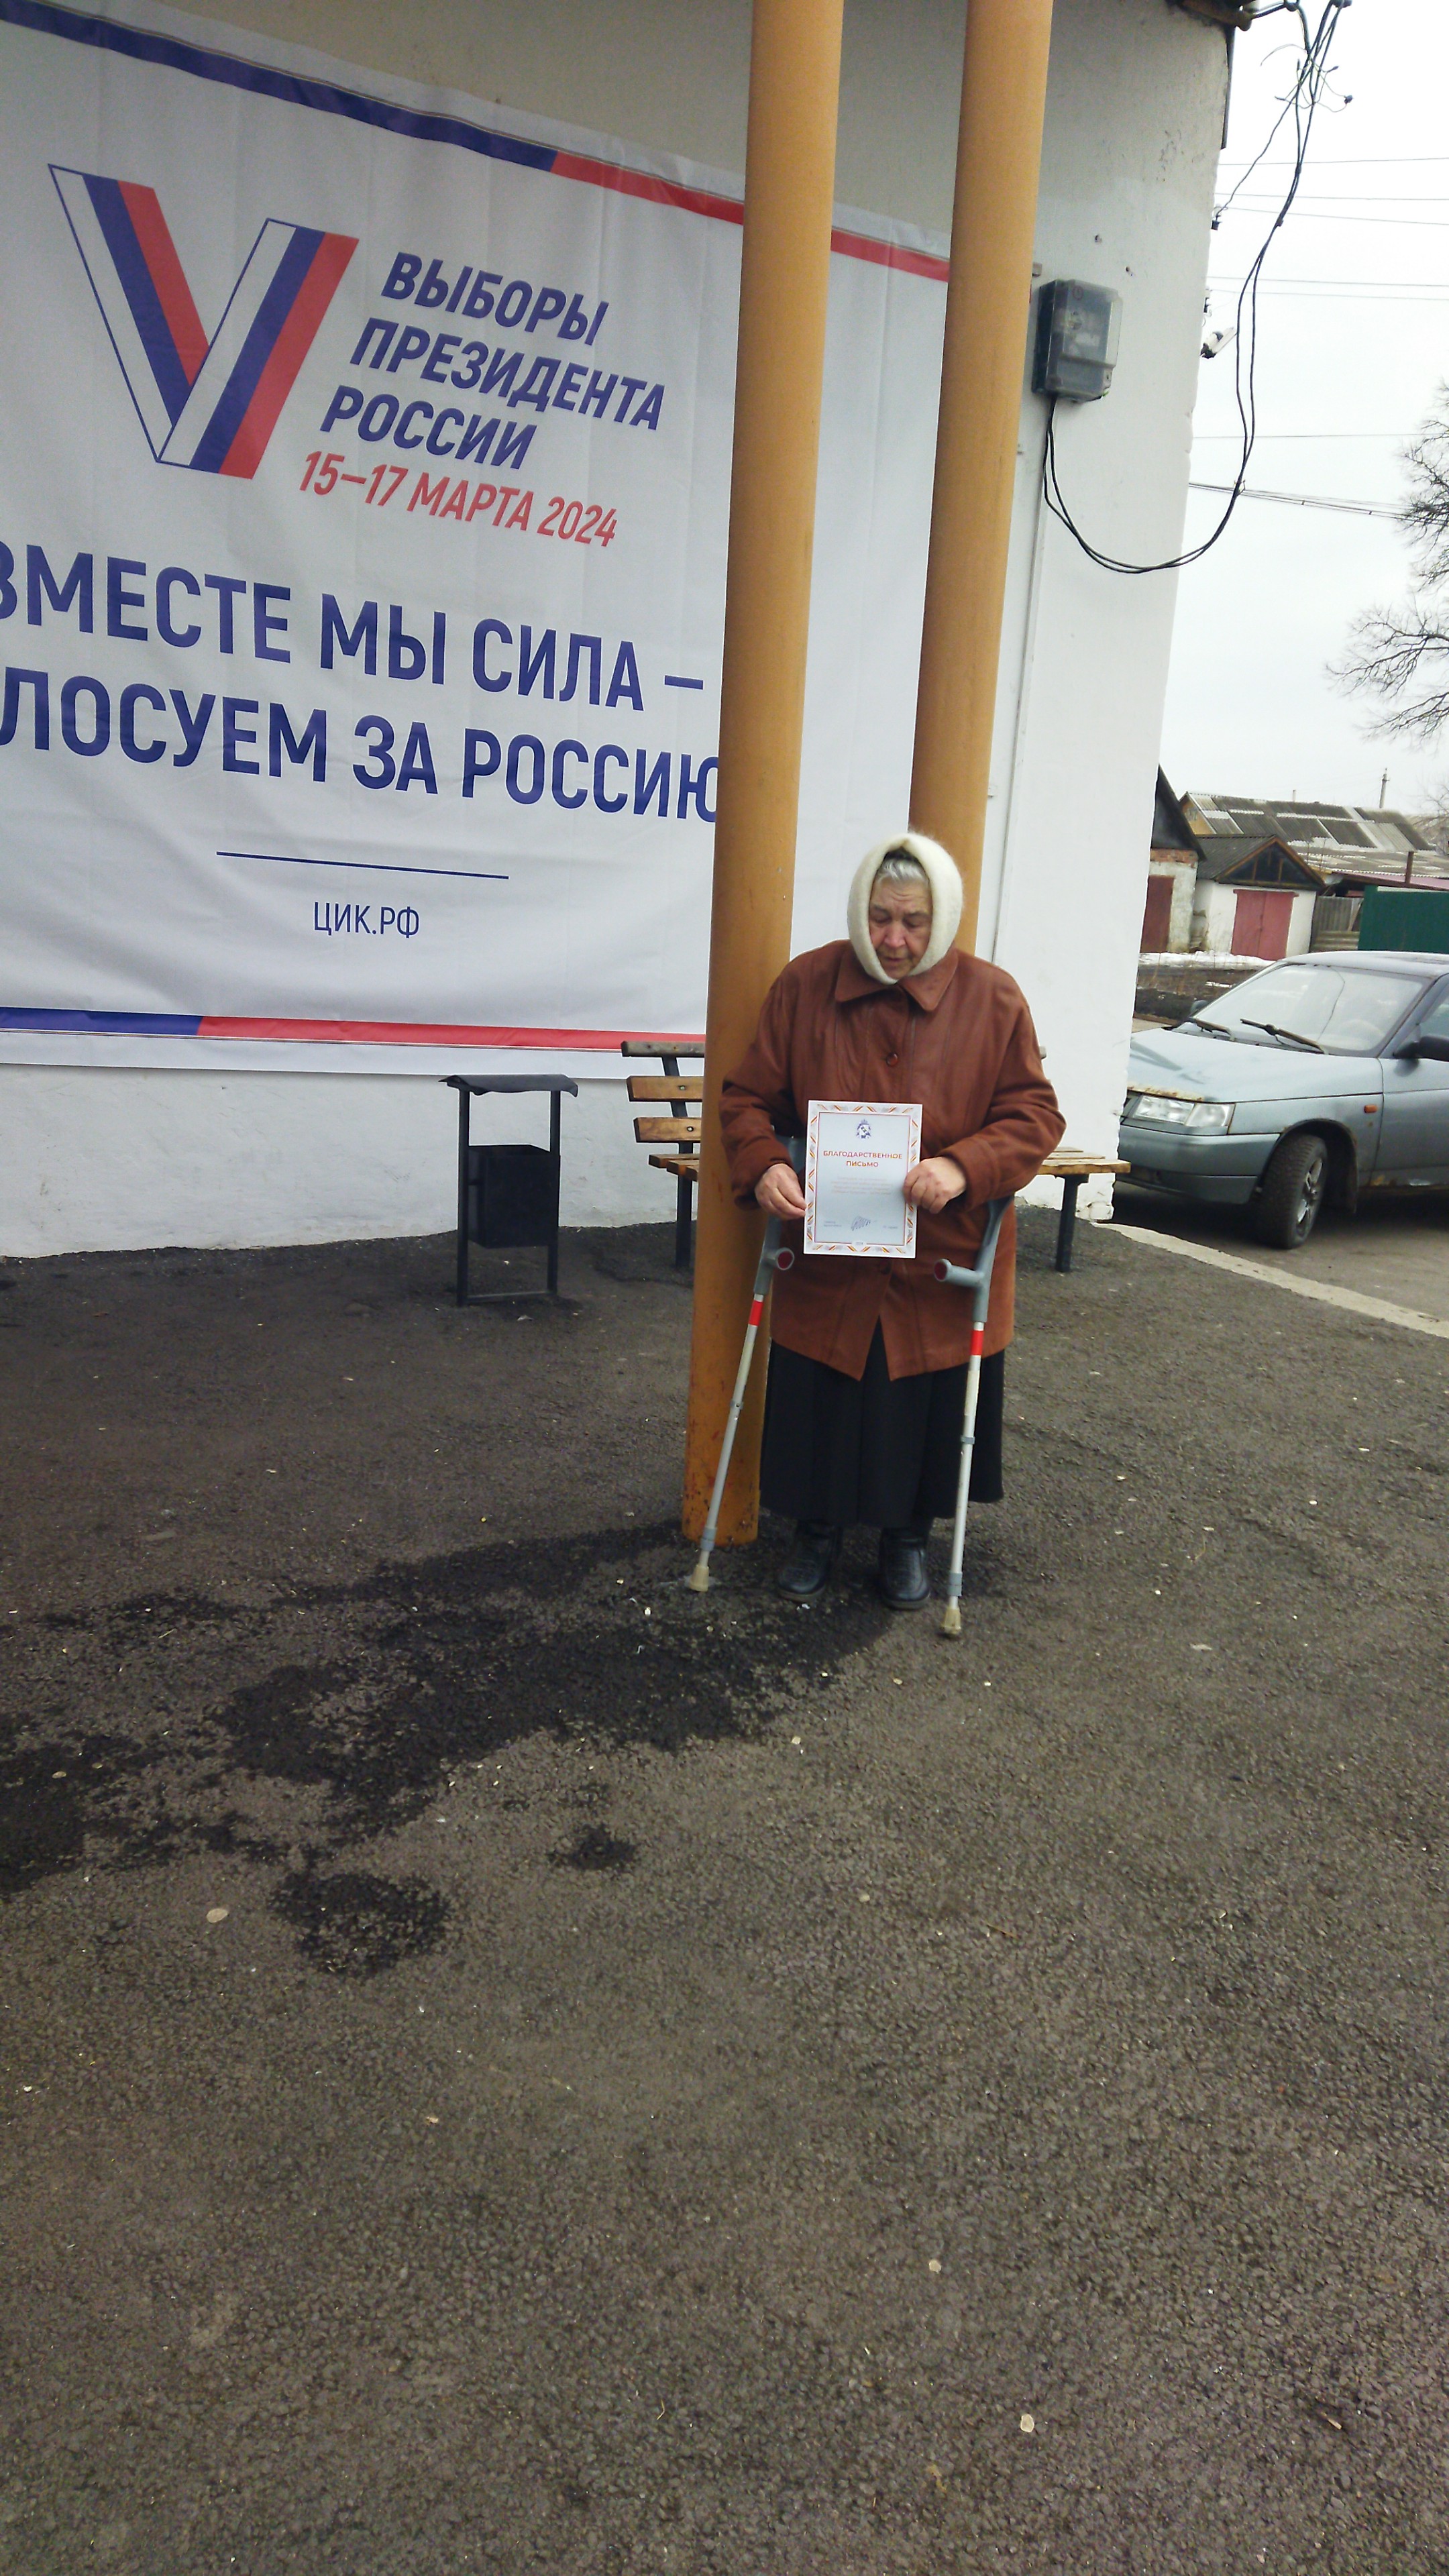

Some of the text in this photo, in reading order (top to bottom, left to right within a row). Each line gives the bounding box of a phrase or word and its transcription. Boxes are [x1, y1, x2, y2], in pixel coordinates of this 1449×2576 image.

[381, 252, 608, 346] ВЫБОРЫ
[351, 318, 665, 431] ПРЕЗИДЕНТА
[320, 386, 537, 470] РОССИИ
[407, 472, 534, 531] МАРТА
[537, 497, 617, 547] 2024
[320, 594, 446, 685] МЫ
[472, 619, 644, 711] СИЛА
[0, 666, 719, 823] ЛОСУЕМ ЗА РОССИЮ
[313, 902, 419, 938] ЦИК.РФ
[823, 1150, 902, 1159] БЛАГОДАРСТВЕННОЕ
